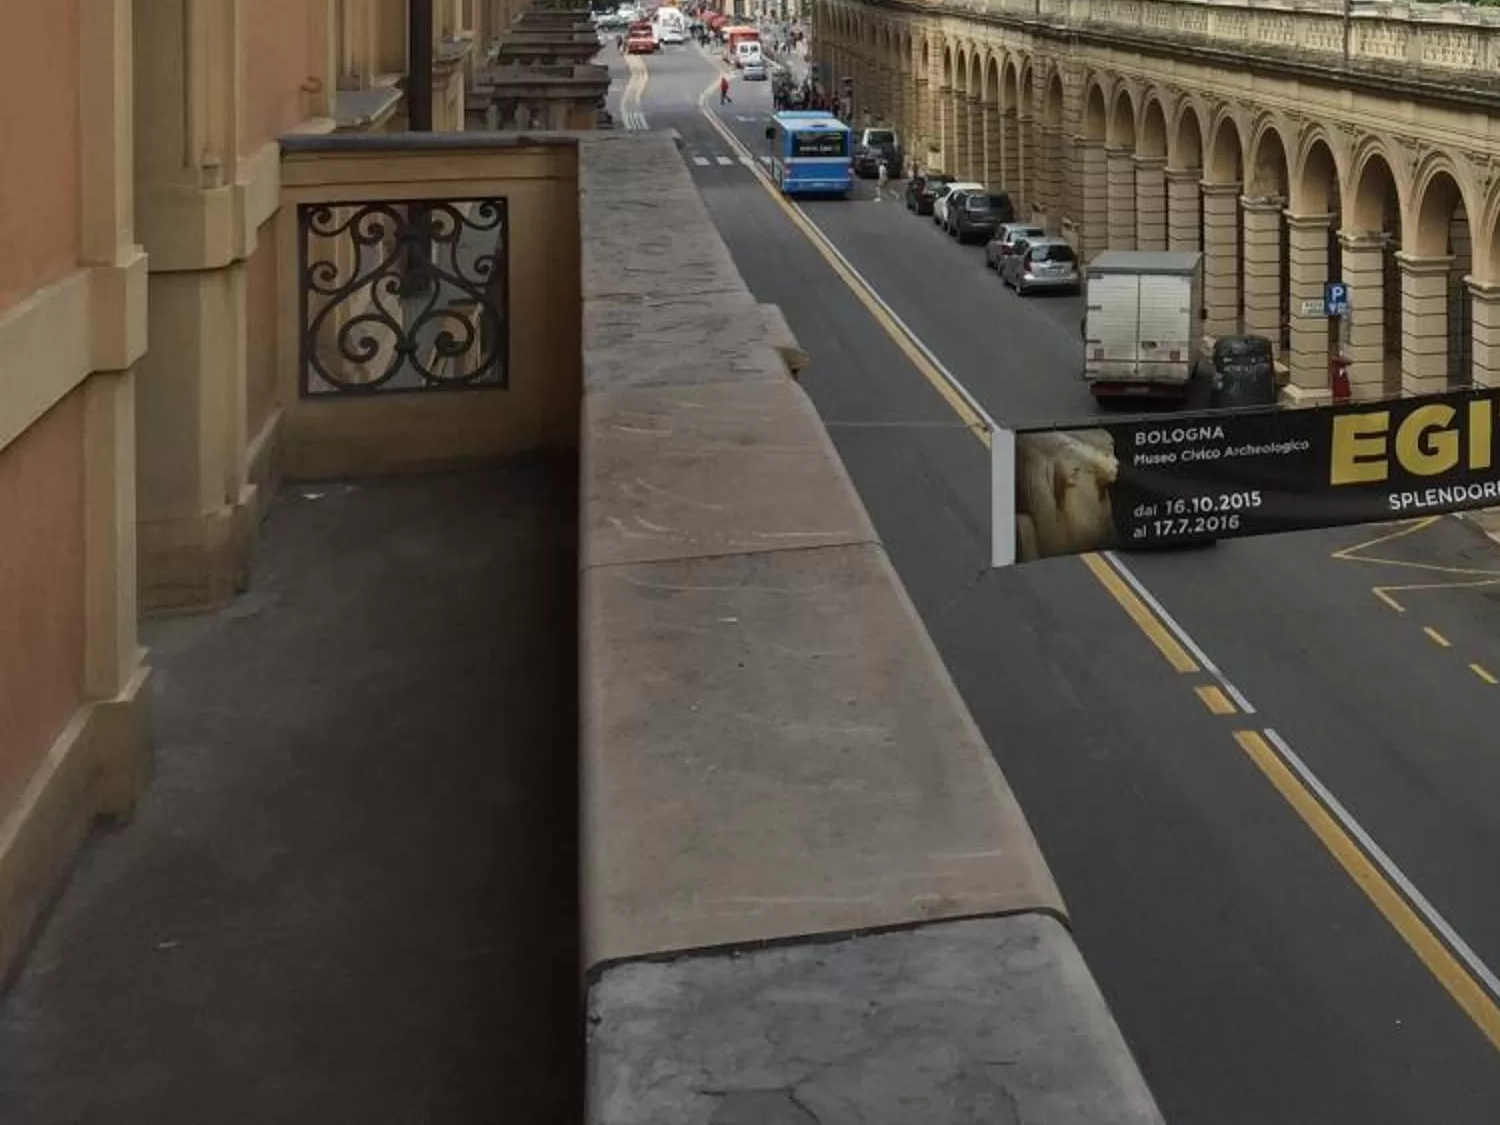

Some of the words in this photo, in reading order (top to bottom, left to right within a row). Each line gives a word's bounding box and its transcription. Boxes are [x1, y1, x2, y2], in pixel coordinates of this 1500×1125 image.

[1331, 286, 1344, 302] P
[1135, 426, 1225, 446] BOLOGNA
[1133, 452, 1177, 466] Museo
[1181, 447, 1221, 462] Civico
[1223, 438, 1310, 459] Archeologico
[1133, 504, 1158, 518] dal
[1166, 490, 1262, 515] 16.10.2015
[1132, 525, 1147, 539] al
[1154, 514, 1240, 536] 17.7.2016
